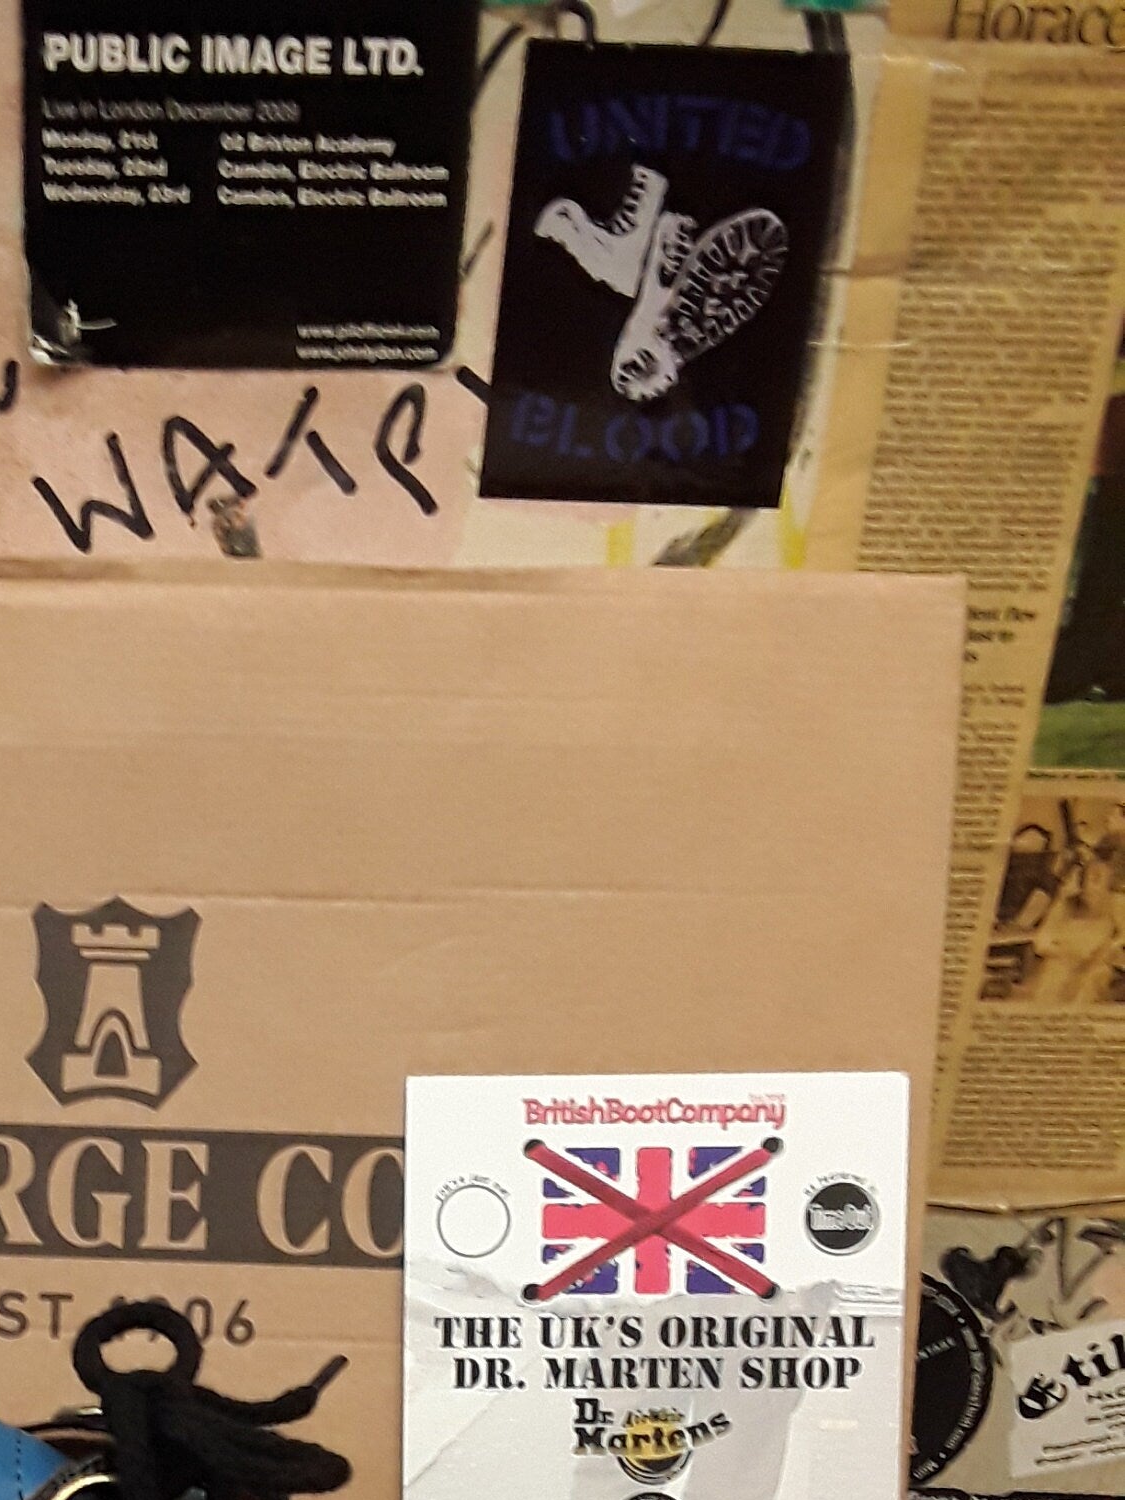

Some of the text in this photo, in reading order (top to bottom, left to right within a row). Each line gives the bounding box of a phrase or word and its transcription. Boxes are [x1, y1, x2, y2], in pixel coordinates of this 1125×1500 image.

[42, 32, 424, 77] PUBLIC IMAGE LTD.
[546, 95, 812, 171] UNITED
[297, 159, 368, 181] Electric
[369, 160, 450, 181] Ballroom
[368, 186, 449, 208] Ballroom
[510, 388, 760, 465] BLOOD
[523, 1096, 786, 1130] BritishBootCompany
[434, 1315, 876, 1349] THE UK'S ORIGINAL
[453, 1356, 863, 1390] DR. MARTEN SHOP
[574, 1411, 732, 1453] Martens
